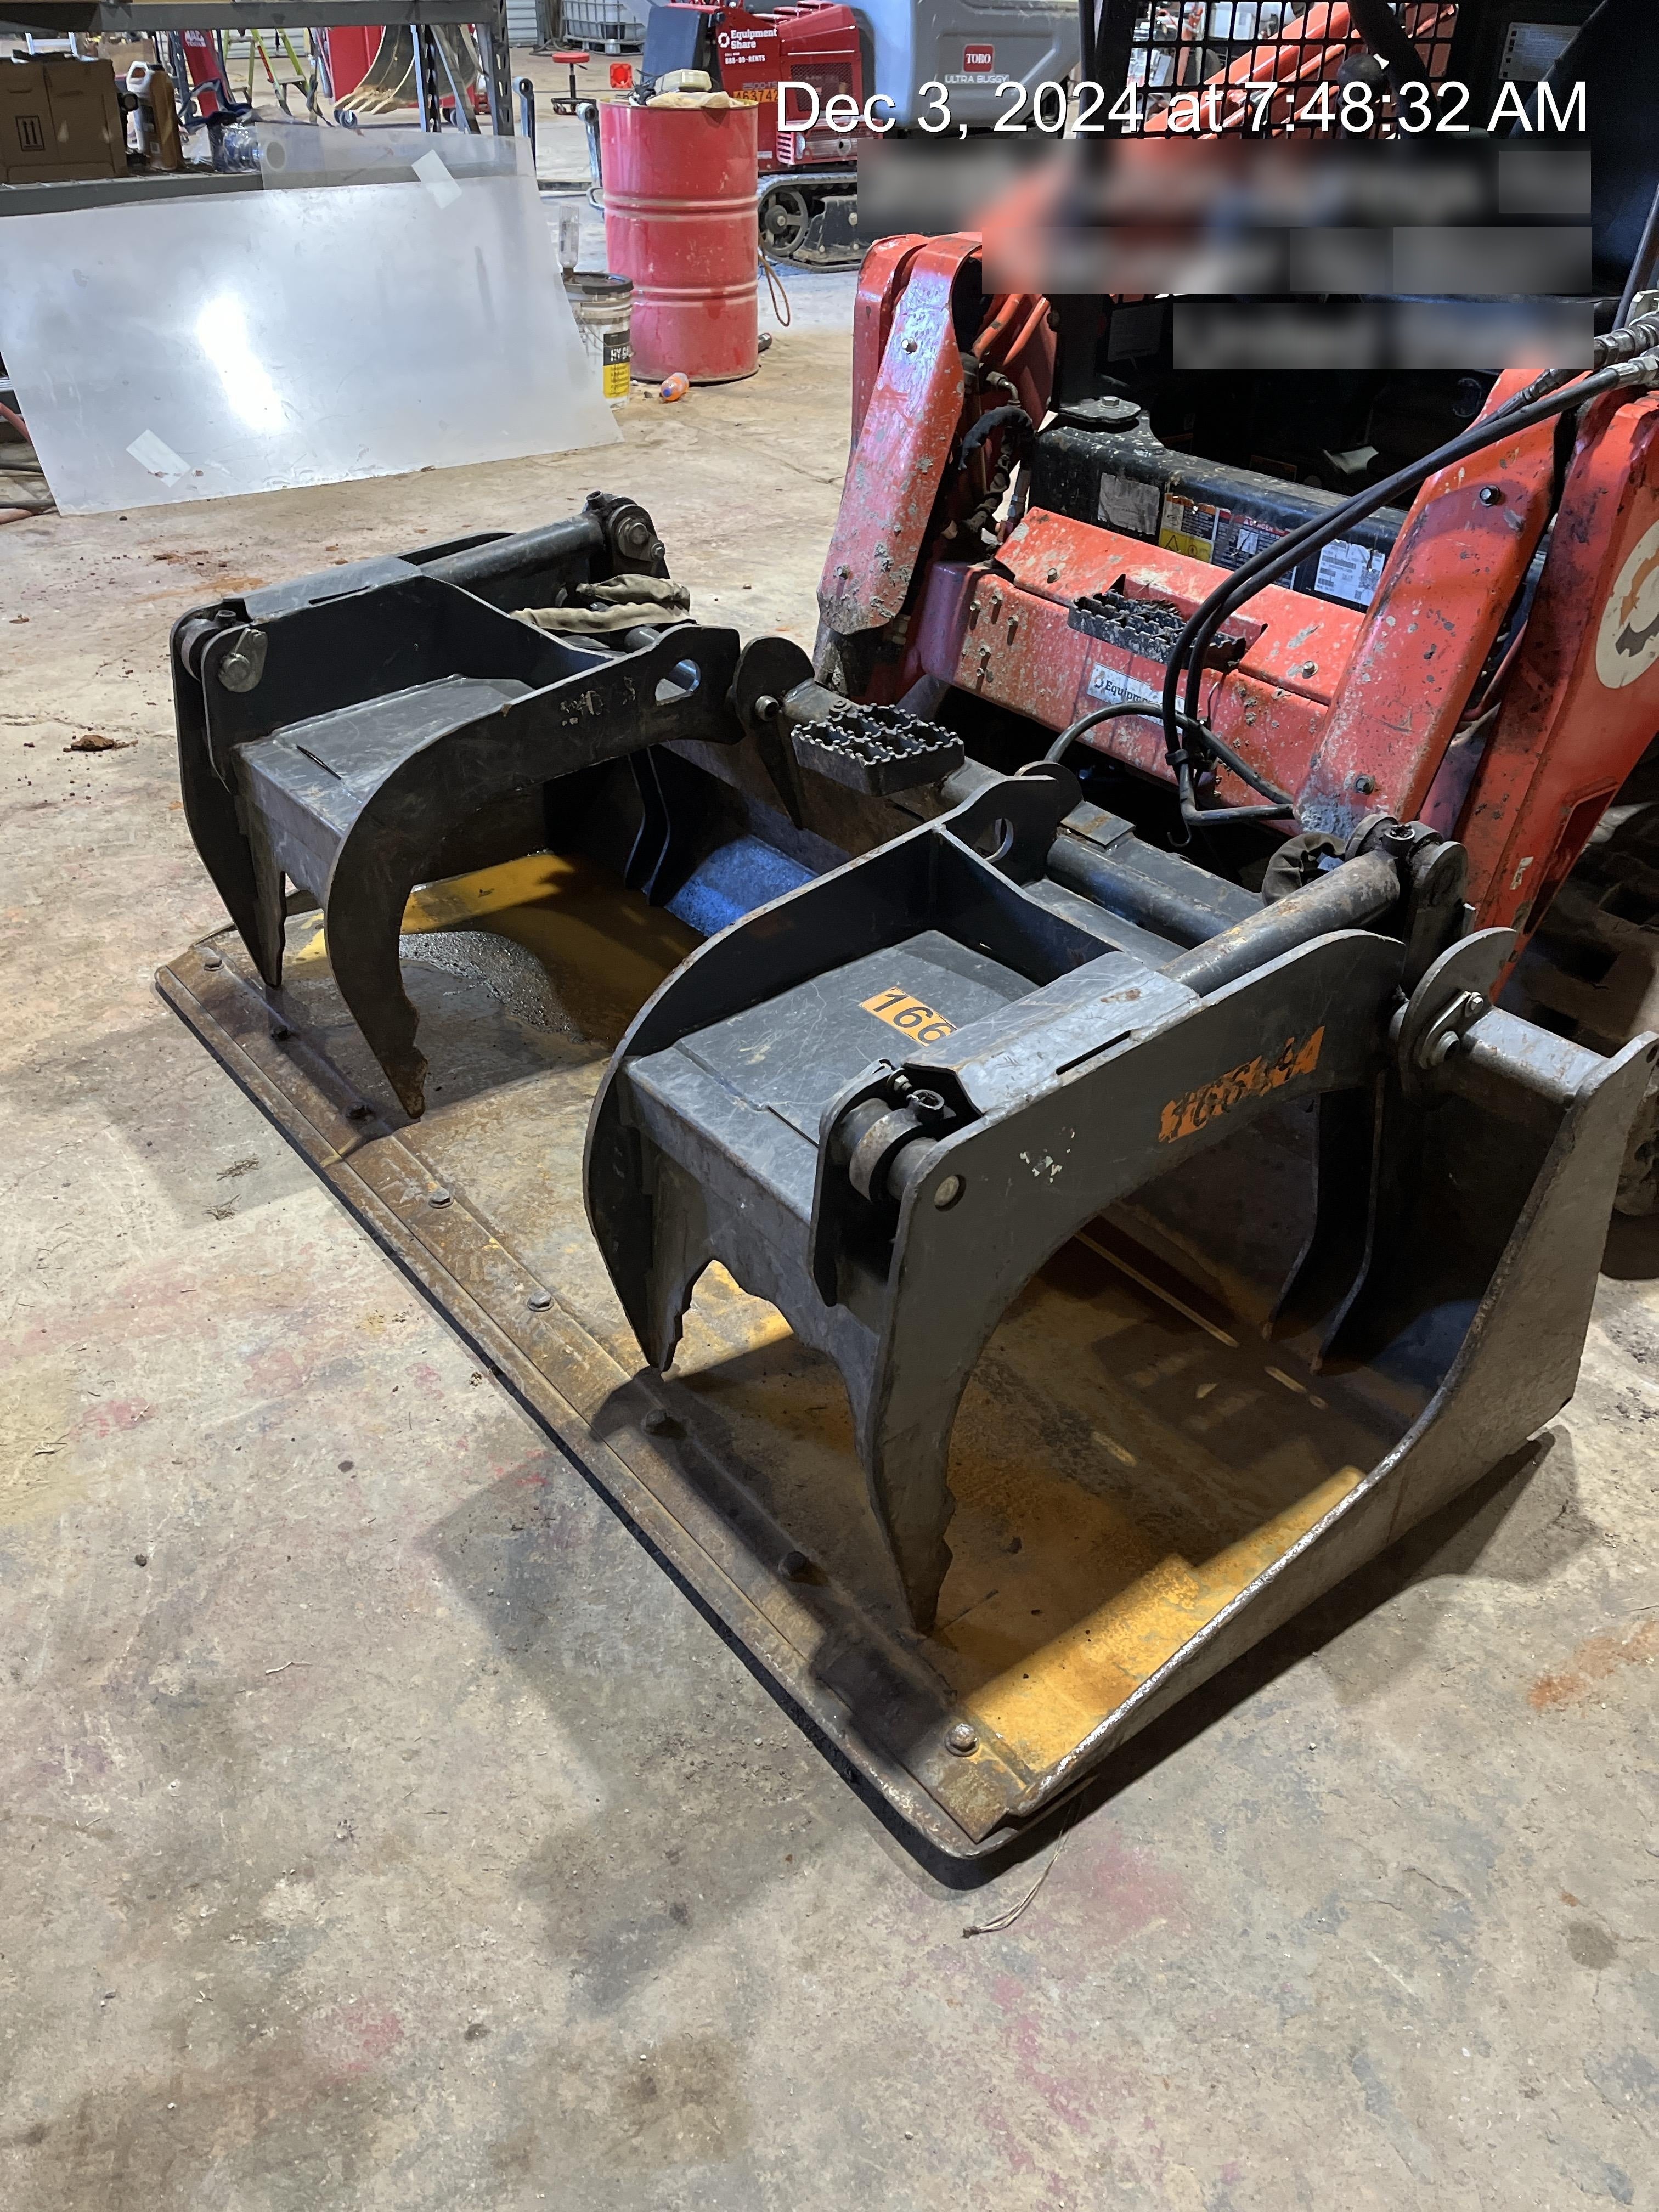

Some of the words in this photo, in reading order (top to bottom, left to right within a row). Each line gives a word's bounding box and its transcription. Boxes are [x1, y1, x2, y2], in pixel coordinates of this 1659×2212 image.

[731, 24, 777, 40] Equipment
[731, 40, 756, 49] Share
[966, 53, 991, 64] TORO
[944, 74, 975, 83] ULTRA
[977, 74, 1009, 83] BUGGY
[1105, 680, 1158, 703] Equipm
[873, 994, 958, 1044] 166
